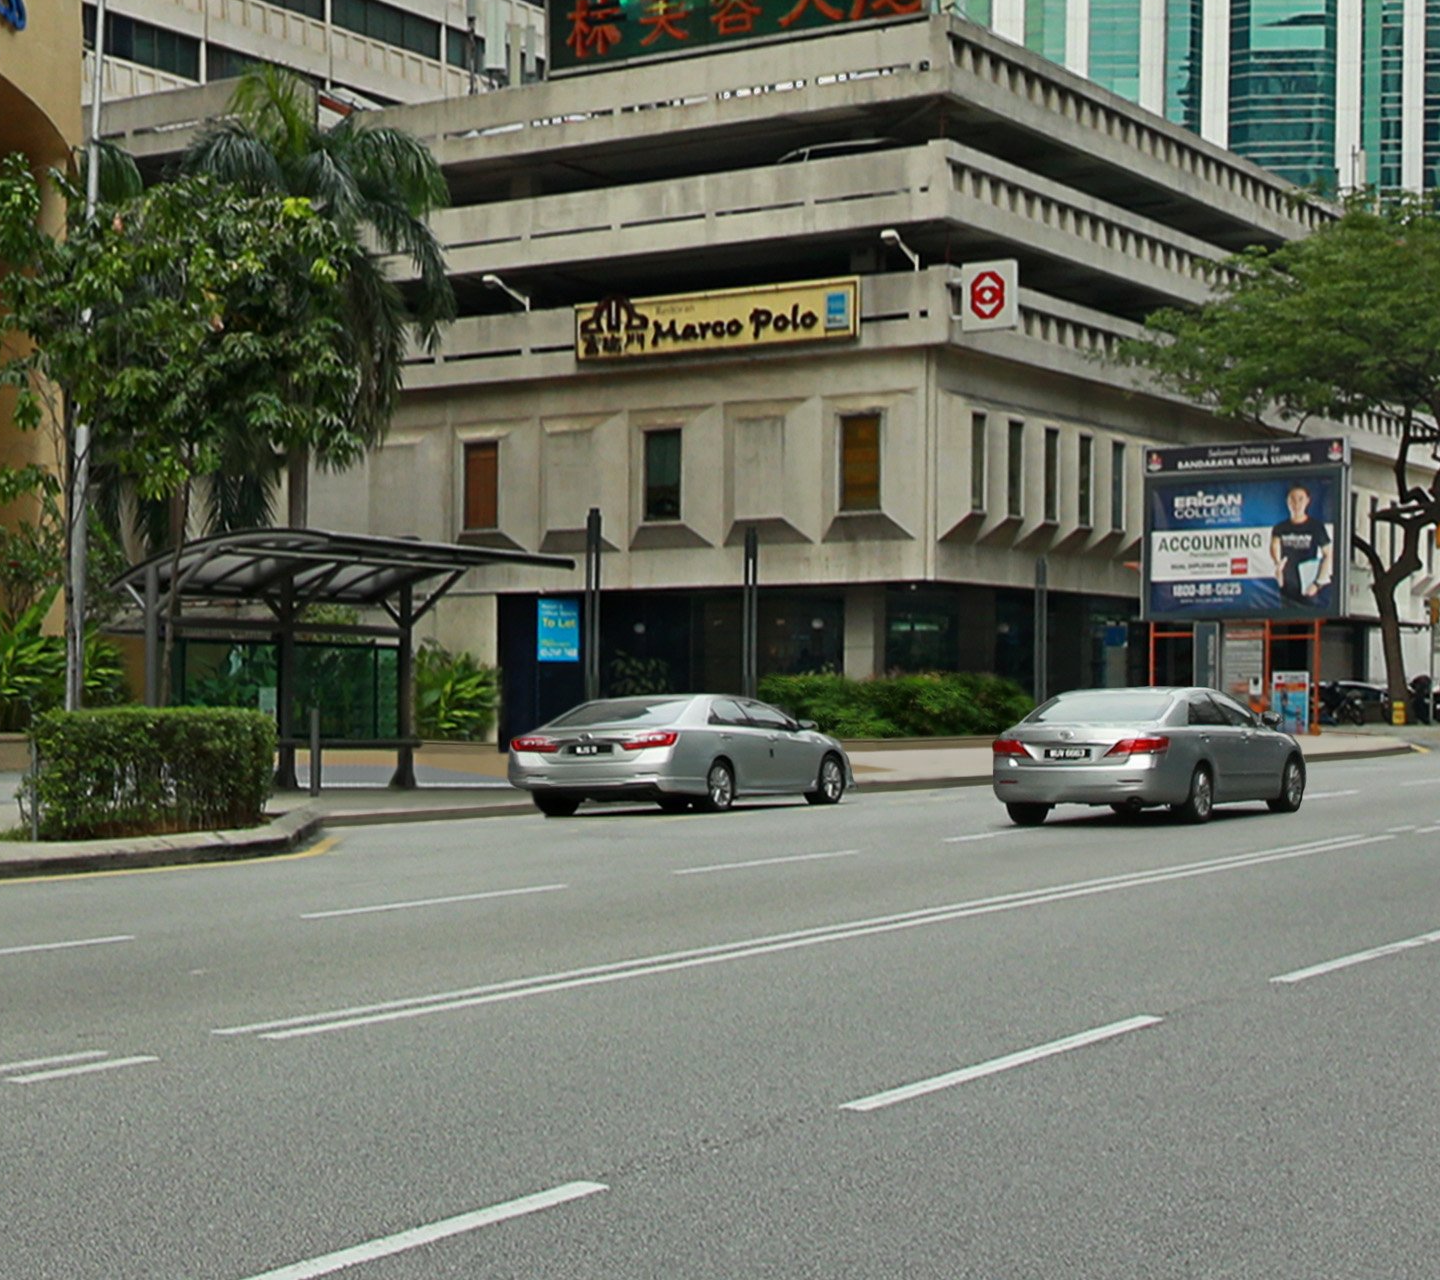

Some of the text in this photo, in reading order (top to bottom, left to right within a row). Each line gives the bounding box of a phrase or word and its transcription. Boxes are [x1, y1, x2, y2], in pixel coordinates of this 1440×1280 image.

[651, 303, 819, 347] Marco Polo
[1177, 452, 1311, 470] BANDARAYA KUALA LUMPUR
[1174, 505, 1241, 520] COLLEGE
[1158, 533, 1263, 552] ACCOUNTING
